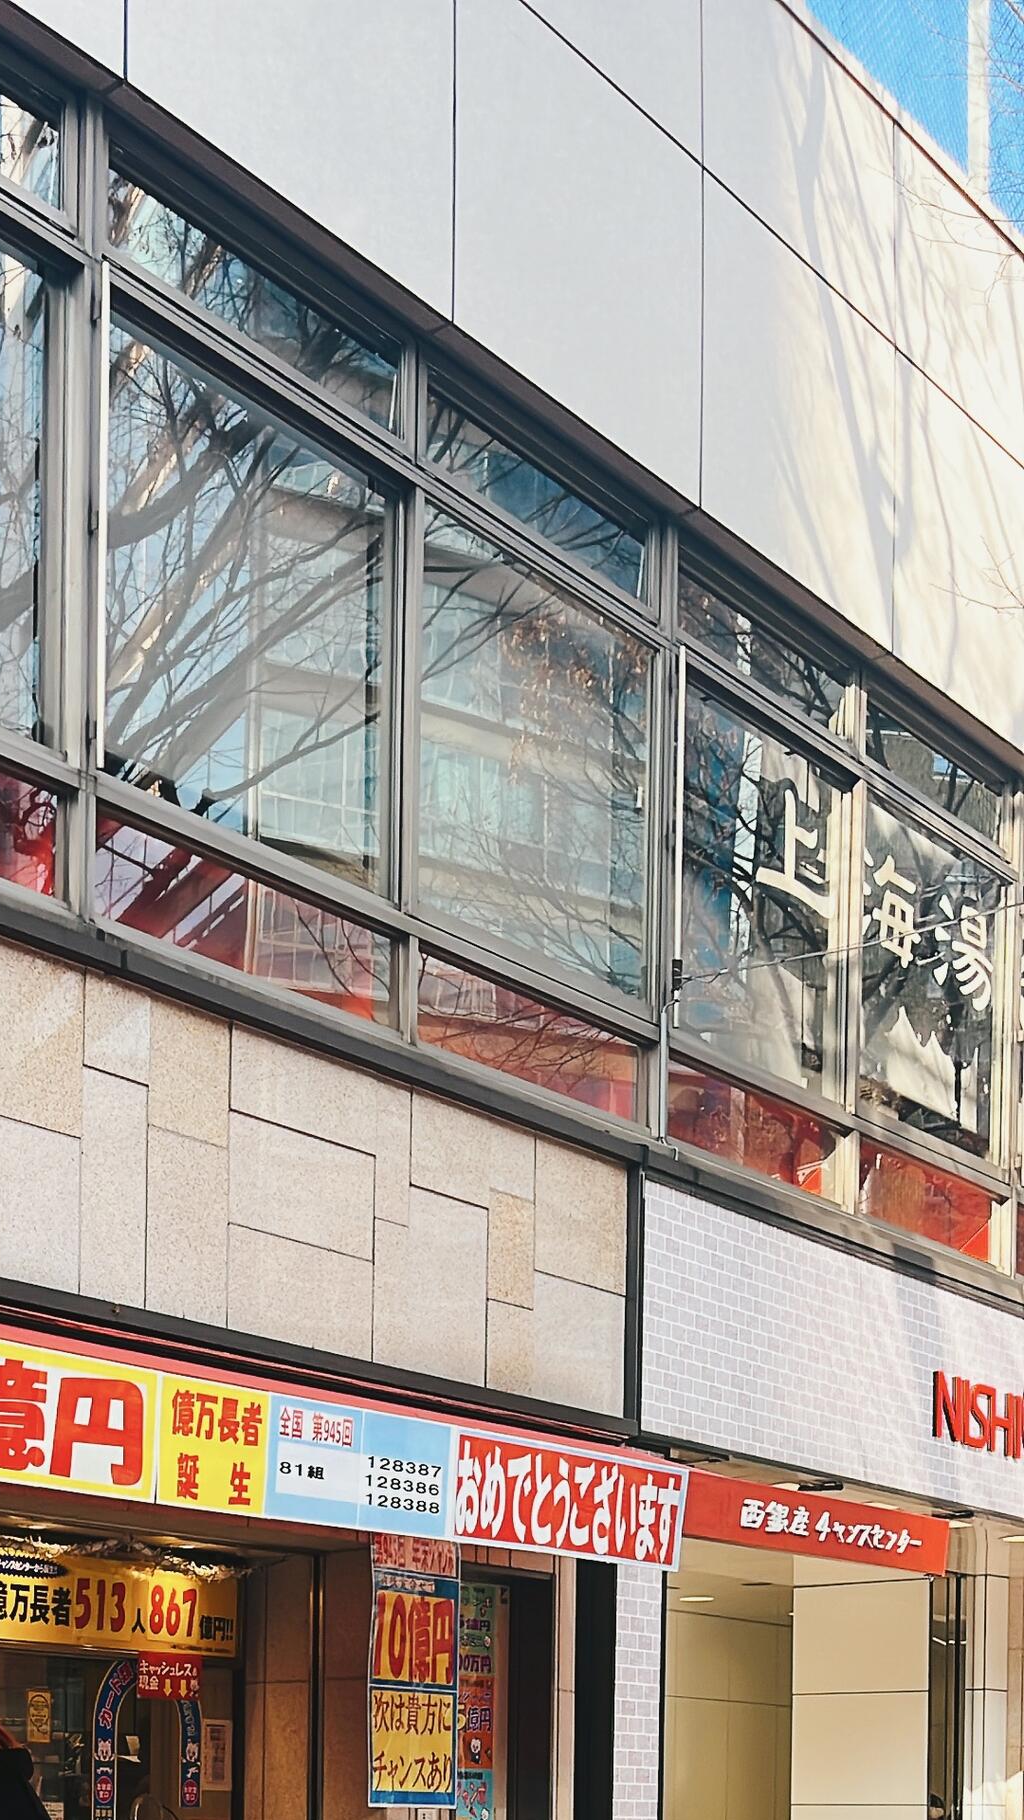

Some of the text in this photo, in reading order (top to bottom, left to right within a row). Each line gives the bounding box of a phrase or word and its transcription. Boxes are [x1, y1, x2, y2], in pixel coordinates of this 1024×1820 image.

[172, 1390, 261, 1447] 億万長者
[279, 1405, 354, 1448] 全国 第945回
[279, 1461, 325, 1481] 81組
[364, 1474, 440, 1496] 128386
[367, 1455, 442, 1477] 128387
[365, 1493, 440, 1515] 128388
[455, 1441, 681, 1563] おめでとうございます
[374, 1592, 453, 1684] 10億円
[374, 1693, 452, 1734] 次は貴方に
[373, 1751, 452, 1792] チャンスあり
